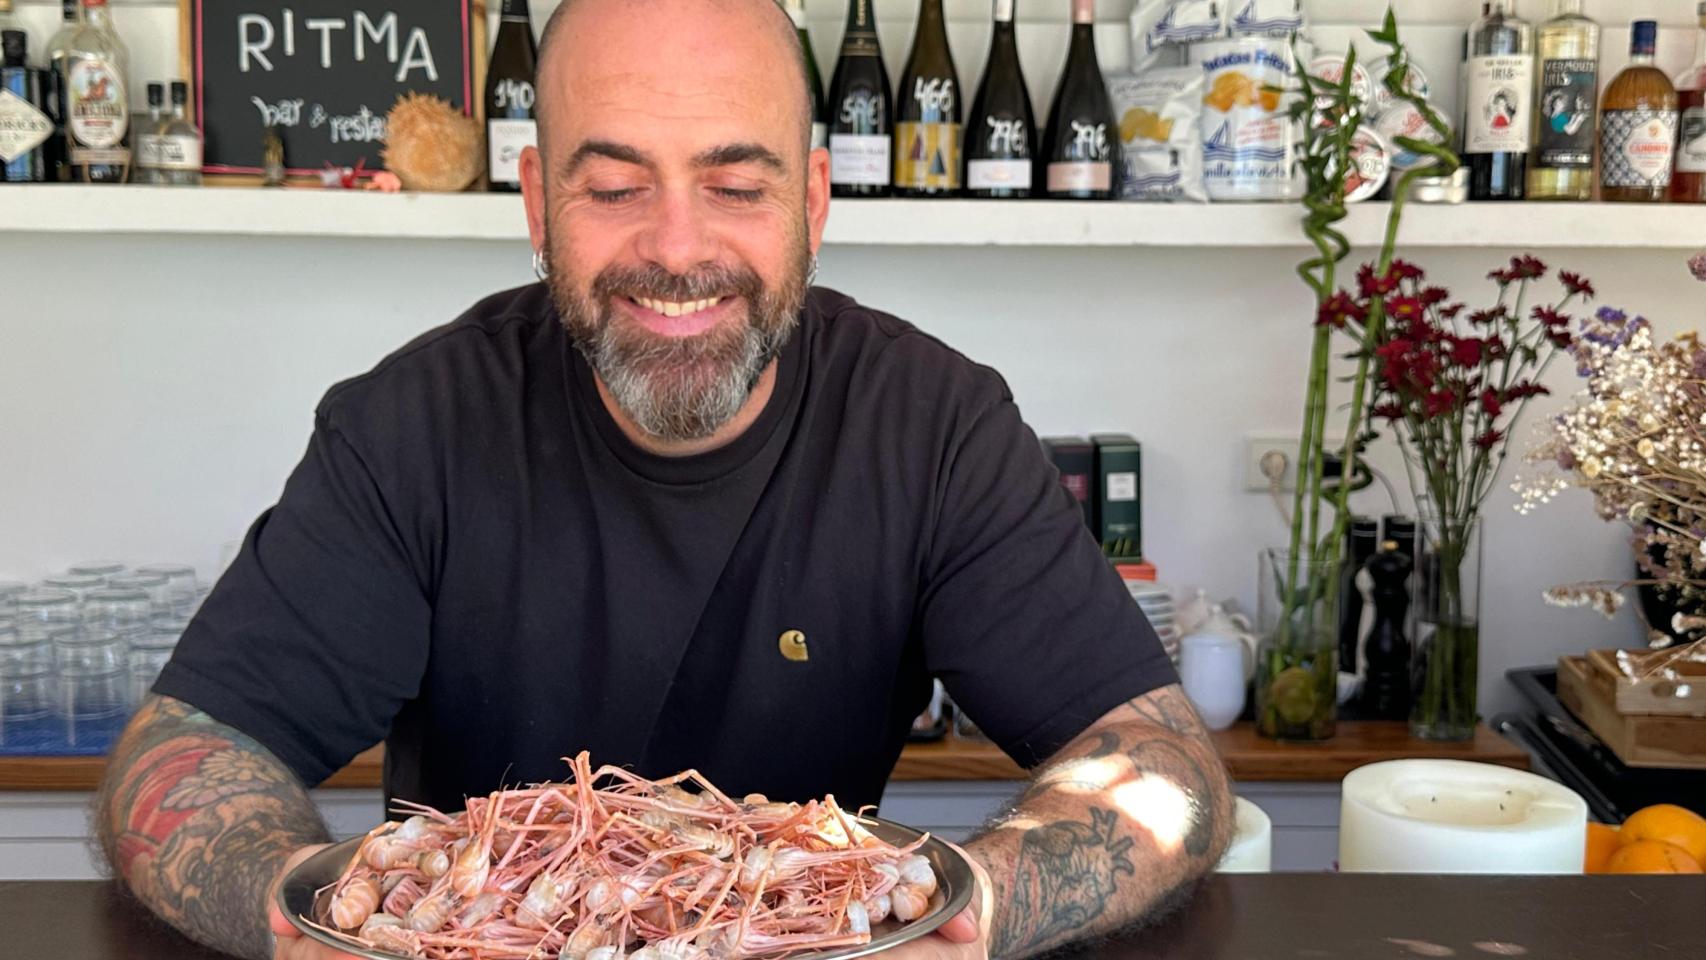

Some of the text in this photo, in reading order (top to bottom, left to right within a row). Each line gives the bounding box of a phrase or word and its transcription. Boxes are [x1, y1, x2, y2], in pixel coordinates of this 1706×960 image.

[238, 8, 438, 82] RITMA
[251, 96, 388, 143] bar & resta
